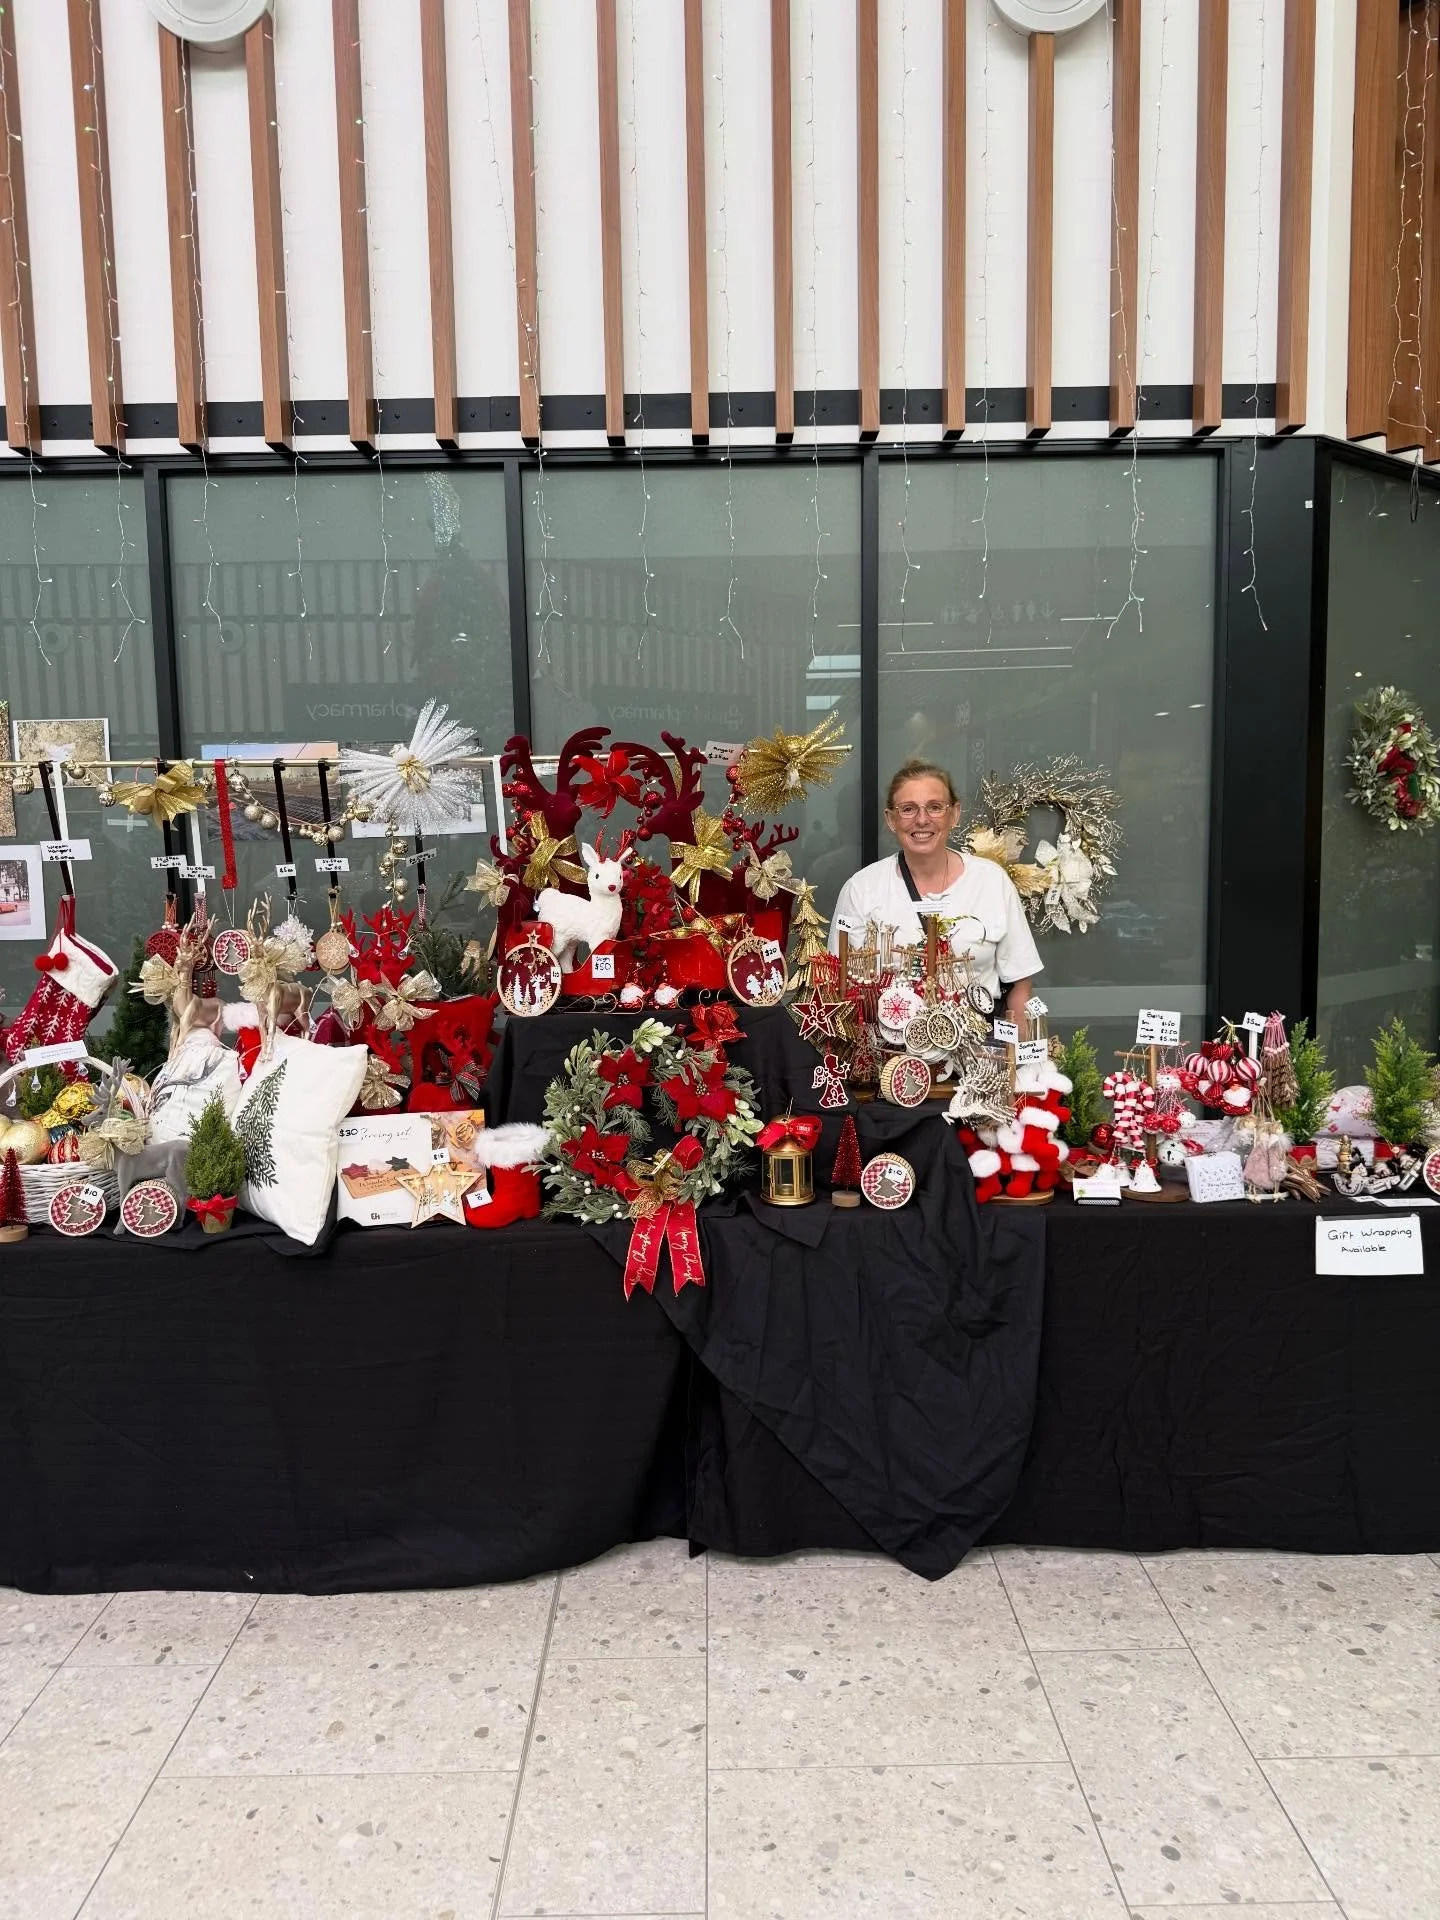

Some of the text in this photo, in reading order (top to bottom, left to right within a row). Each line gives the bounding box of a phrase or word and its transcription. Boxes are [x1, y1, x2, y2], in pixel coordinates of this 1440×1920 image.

[594, 962, 612, 971] $50
[338, 1128, 359, 1138] $30
[888, 1166, 903, 1176] $10
[84, 1187, 98, 1197] $10
[1327, 1227, 1413, 1241] Gift Wrapping
[1340, 1243, 1387, 1254] Available
